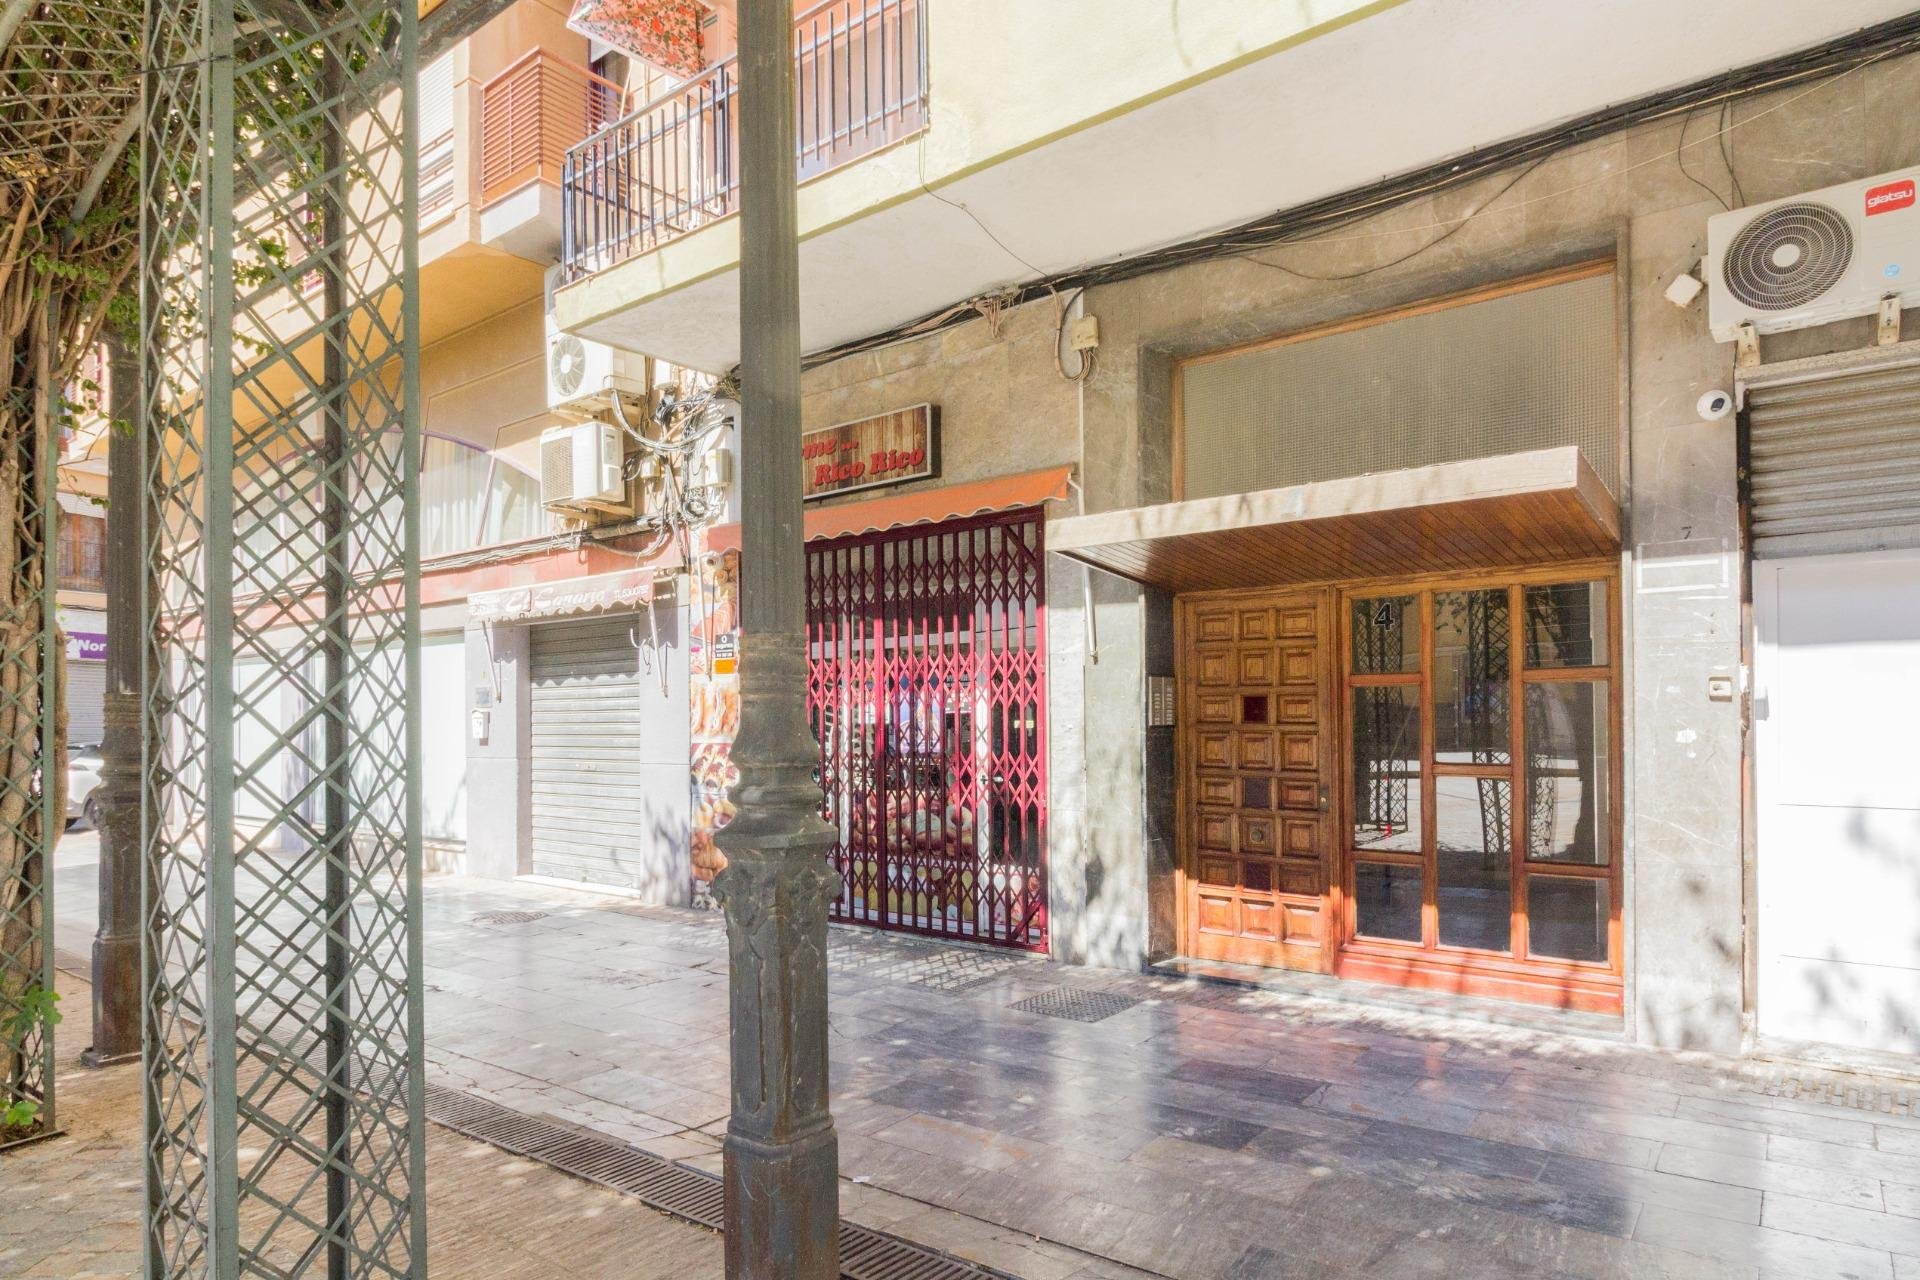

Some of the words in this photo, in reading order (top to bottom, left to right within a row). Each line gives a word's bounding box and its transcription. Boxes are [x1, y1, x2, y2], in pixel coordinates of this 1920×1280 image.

[1867, 189, 1913, 208] giatsu
[802, 439, 837, 460] me
[815, 460, 865, 486] Rico
[870, 448, 925, 475] Rico
[1373, 602, 1395, 631] 4
[79, 639, 107, 652] Nor
